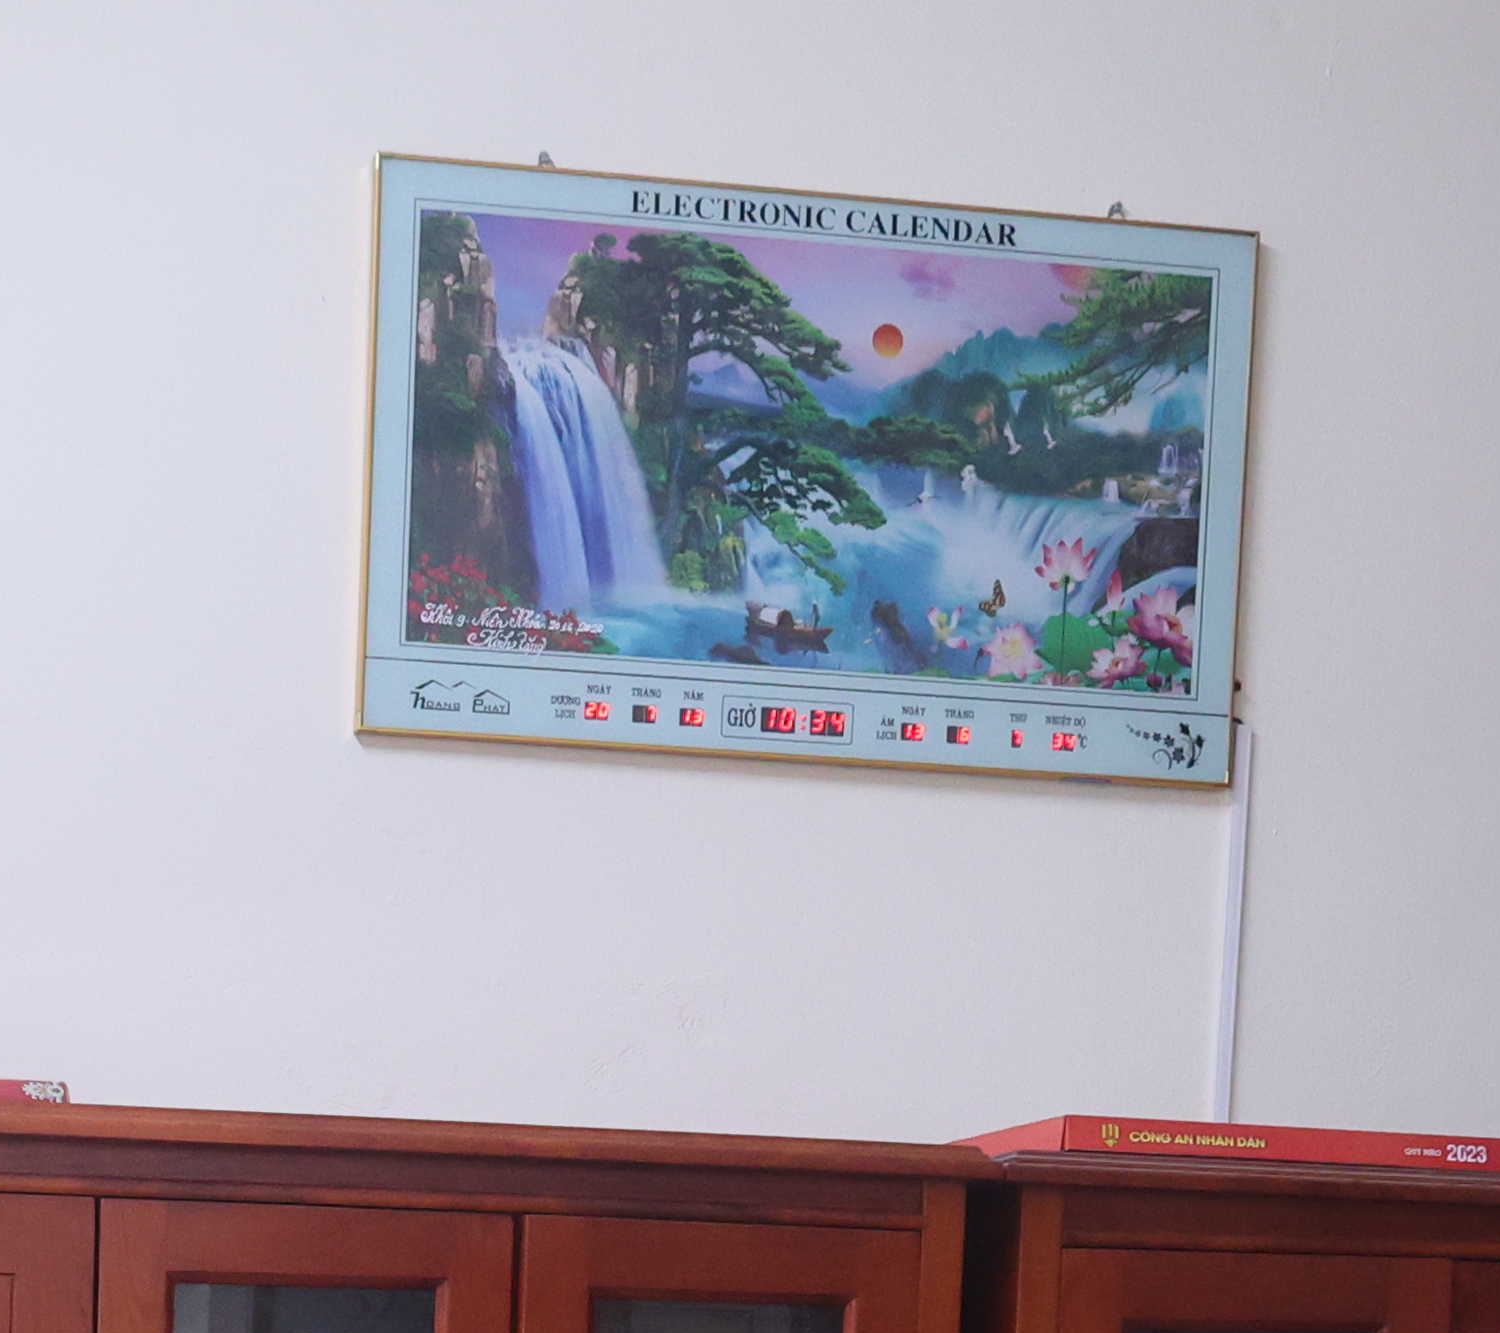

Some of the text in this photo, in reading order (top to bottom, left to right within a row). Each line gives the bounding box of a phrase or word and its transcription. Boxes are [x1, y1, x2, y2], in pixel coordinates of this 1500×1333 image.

[631, 189, 1017, 247] ELECTRONIC CALENDAR
[584, 701, 612, 720] 20
[682, 708, 706, 726] 13
[727, 703, 757, 728] GIỜ
[767, 707, 847, 734] 10:34
[904, 723, 927, 742] 13
[956, 726, 971, 745] 6
[1013, 729, 1025, 746] 7
[1052, 732, 1078, 751] 34
[1129, 1131, 1266, 1148] CÔNG AN NHÂN DÂN
[1446, 1144, 1488, 1163] 2023
